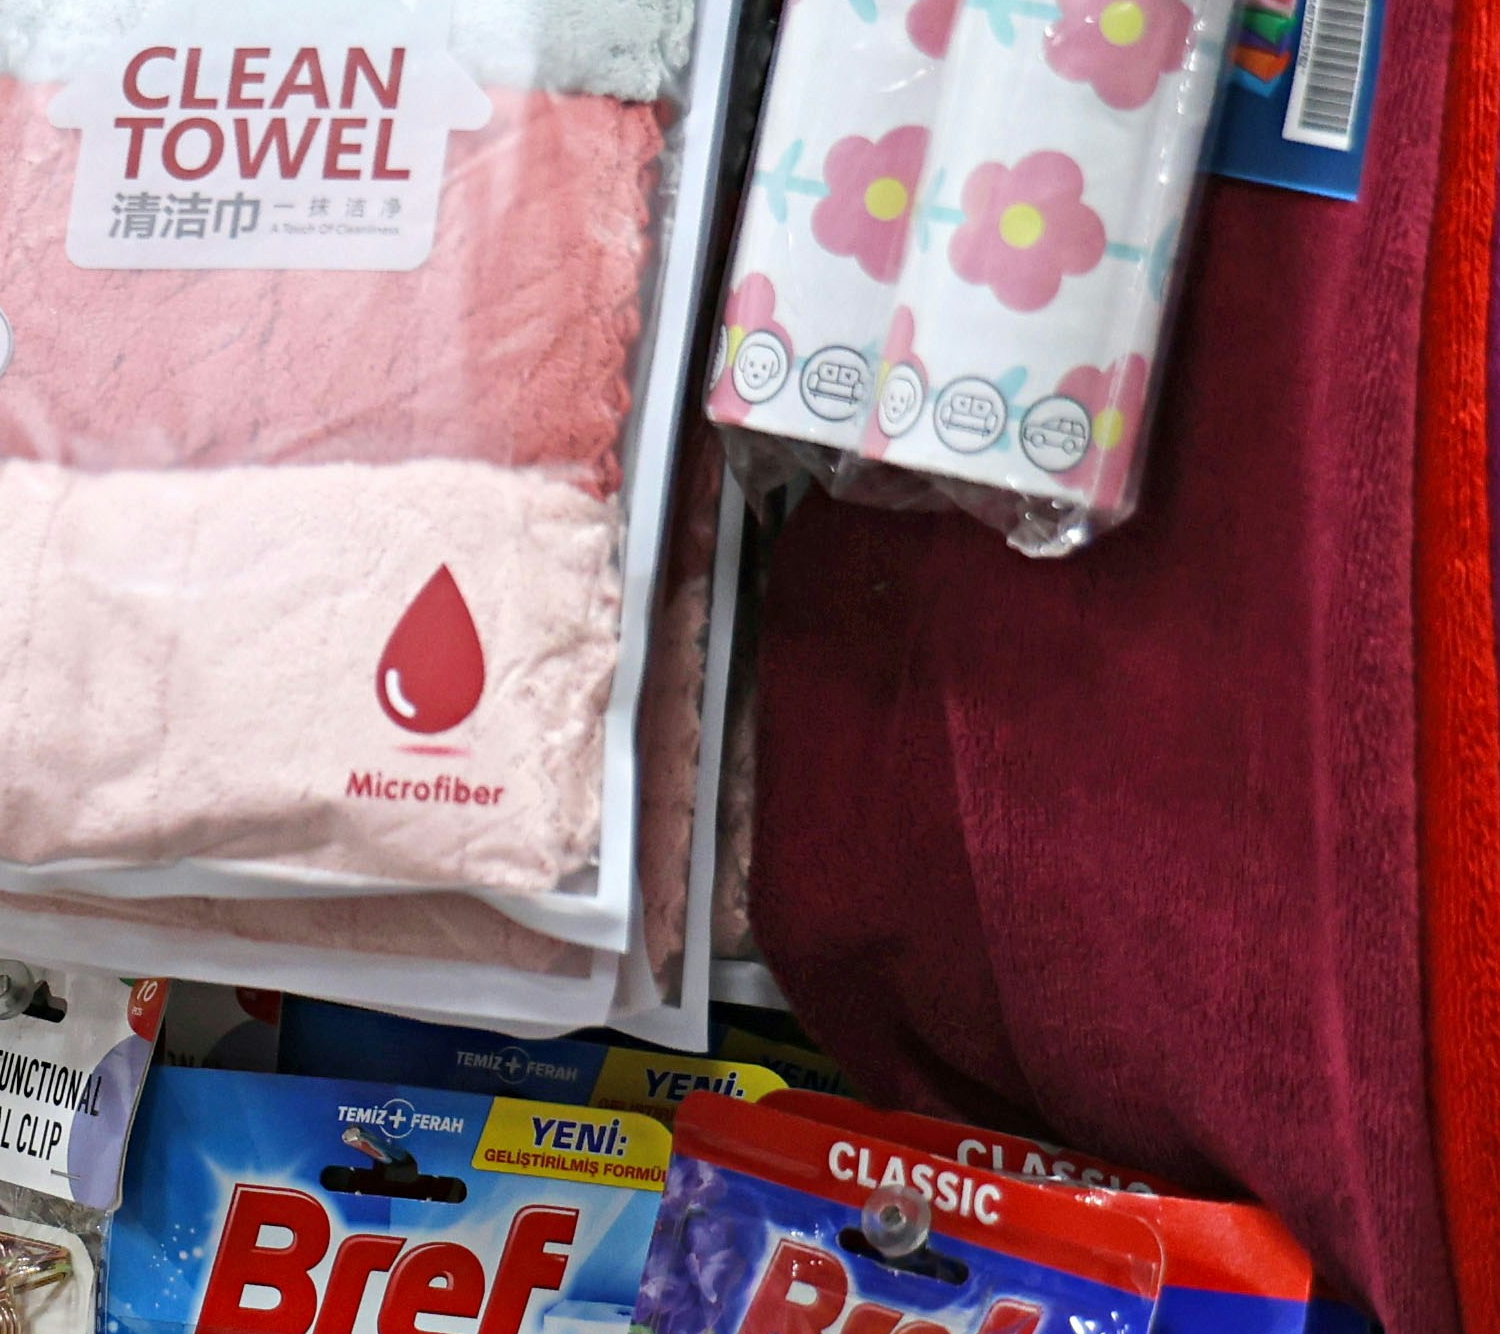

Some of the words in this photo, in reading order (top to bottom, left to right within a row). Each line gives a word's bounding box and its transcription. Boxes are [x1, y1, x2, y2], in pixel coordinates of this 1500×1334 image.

[123, 46, 406, 110] CLEAN
[114, 117, 411, 181] TOWEL
[109, 192, 261, 239] 清洁巾
[345, 771, 505, 807] Microfiber
[136, 979, 159, 1003] 10
[15, 1113, 63, 1161] CLIP
[337, 1104, 387, 1127] TEMİZ
[410, 1113, 464, 1134] FERAH
[531, 1116, 628, 1157] YENİ:
[826, 1141, 1002, 1225] CLASSIC
